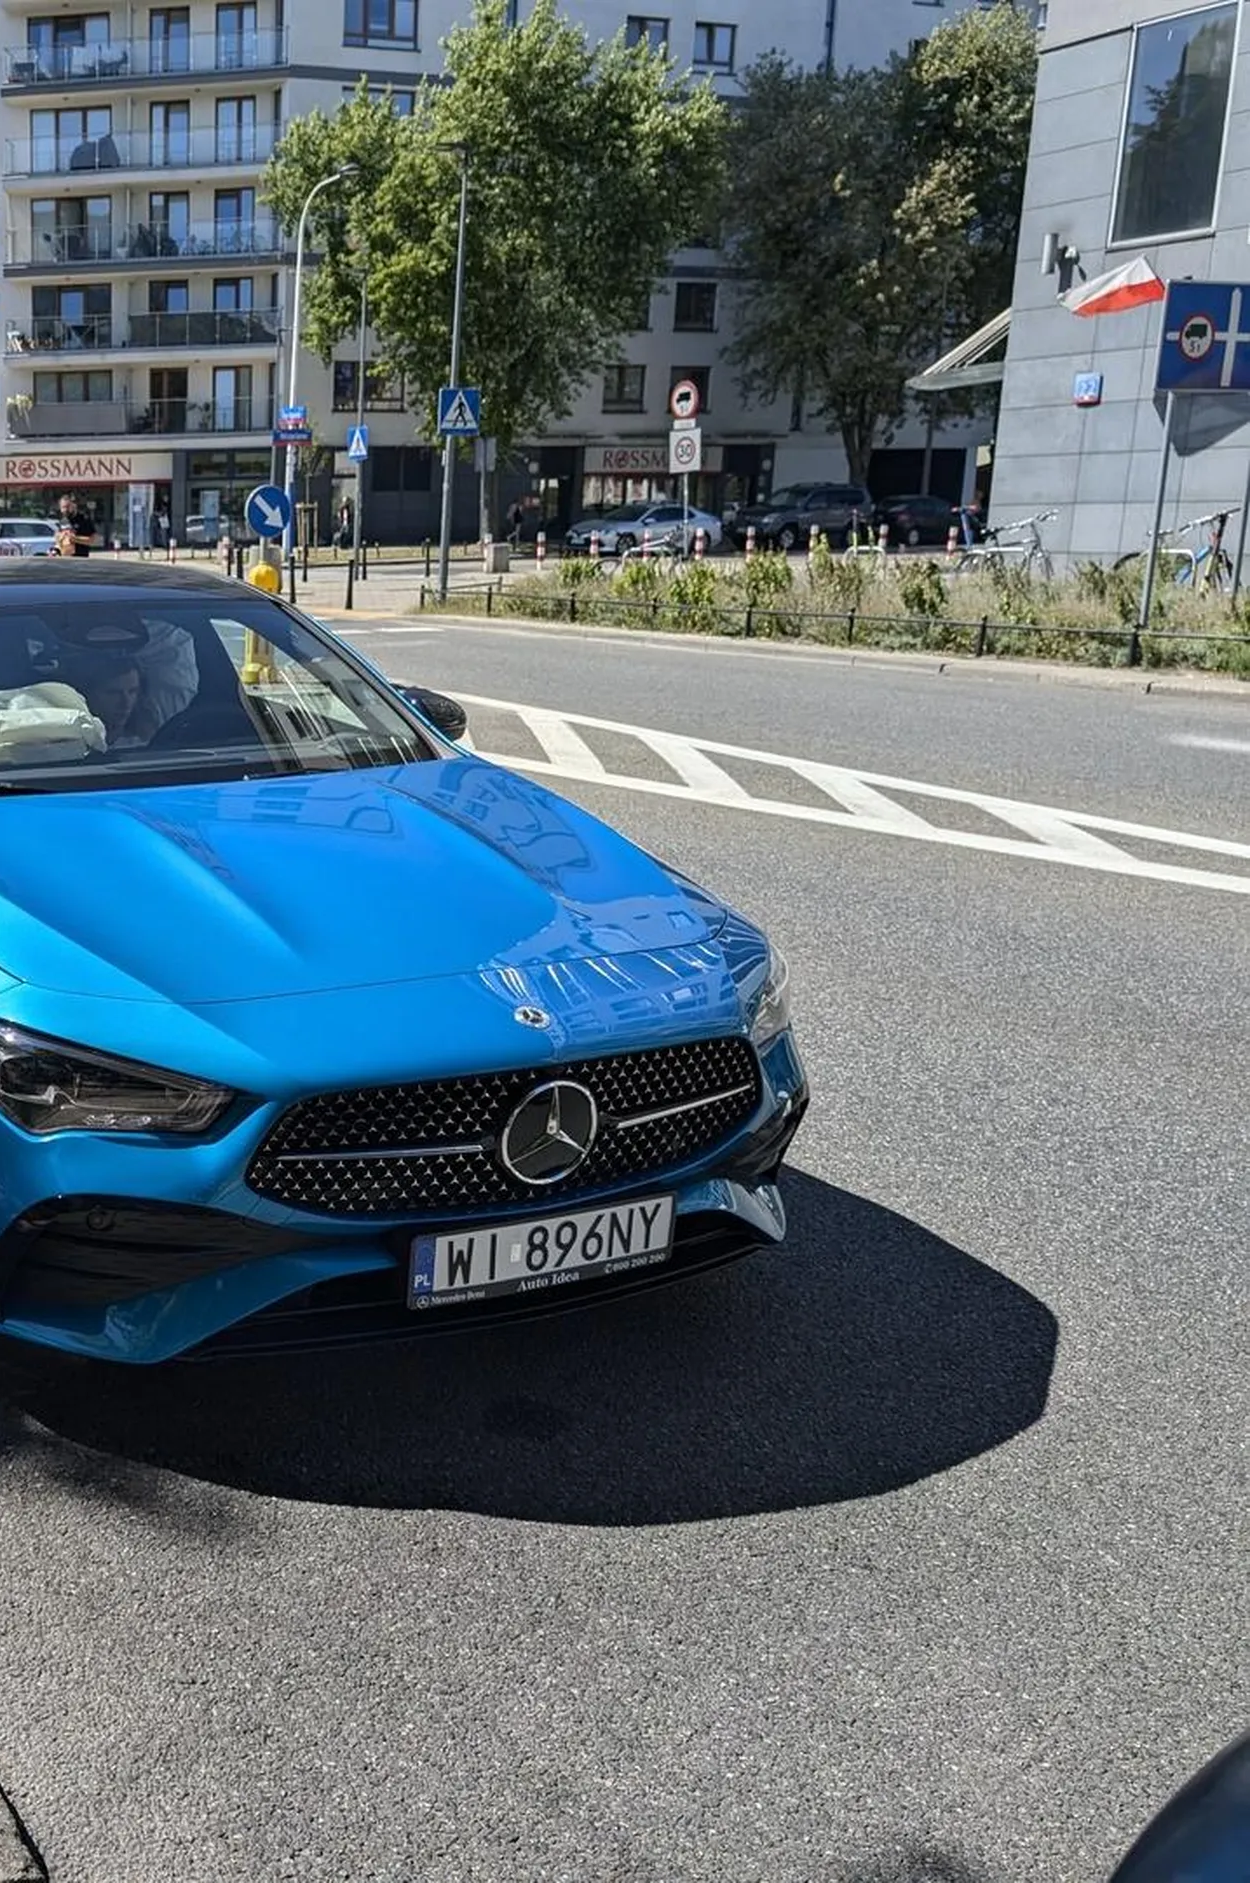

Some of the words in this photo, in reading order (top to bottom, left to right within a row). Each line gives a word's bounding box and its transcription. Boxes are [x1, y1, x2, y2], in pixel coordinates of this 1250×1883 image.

[680, 443, 692, 458] 30
[5, 458, 132, 479] ROSSMANN
[449, 1233, 497, 1287] WI
[525, 1203, 662, 1272] 896NY
[414, 1274, 431, 1288] PL
[516, 1277, 549, 1293] Auto
[550, 1272, 580, 1286] Idea
